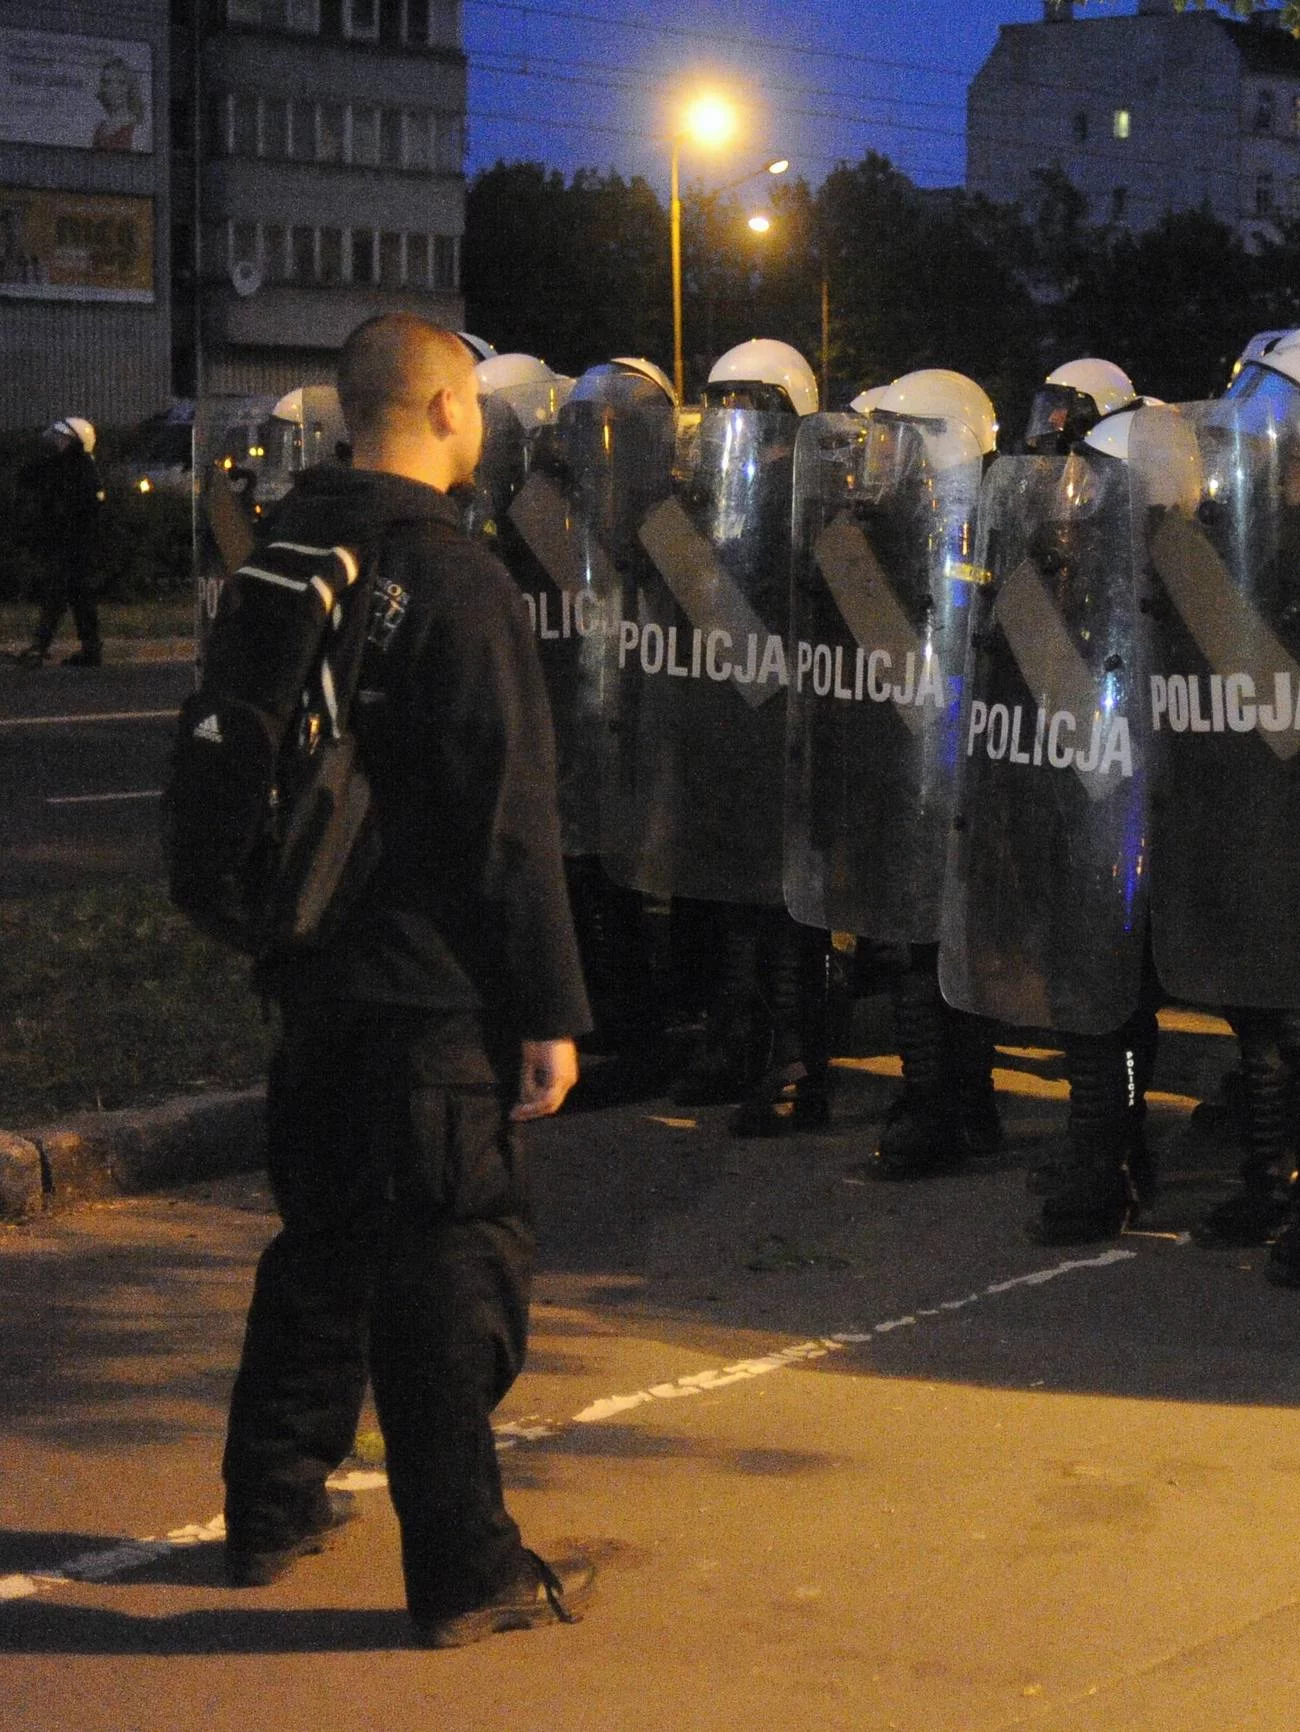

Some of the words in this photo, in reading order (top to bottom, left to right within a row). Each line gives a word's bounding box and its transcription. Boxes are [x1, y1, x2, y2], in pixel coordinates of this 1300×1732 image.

[619, 620, 789, 686] POLICJA
[797, 640, 945, 708] POLICJA
[966, 699, 1134, 777] POLICJA
[1126, 1050, 1135, 1107] POLICJA
